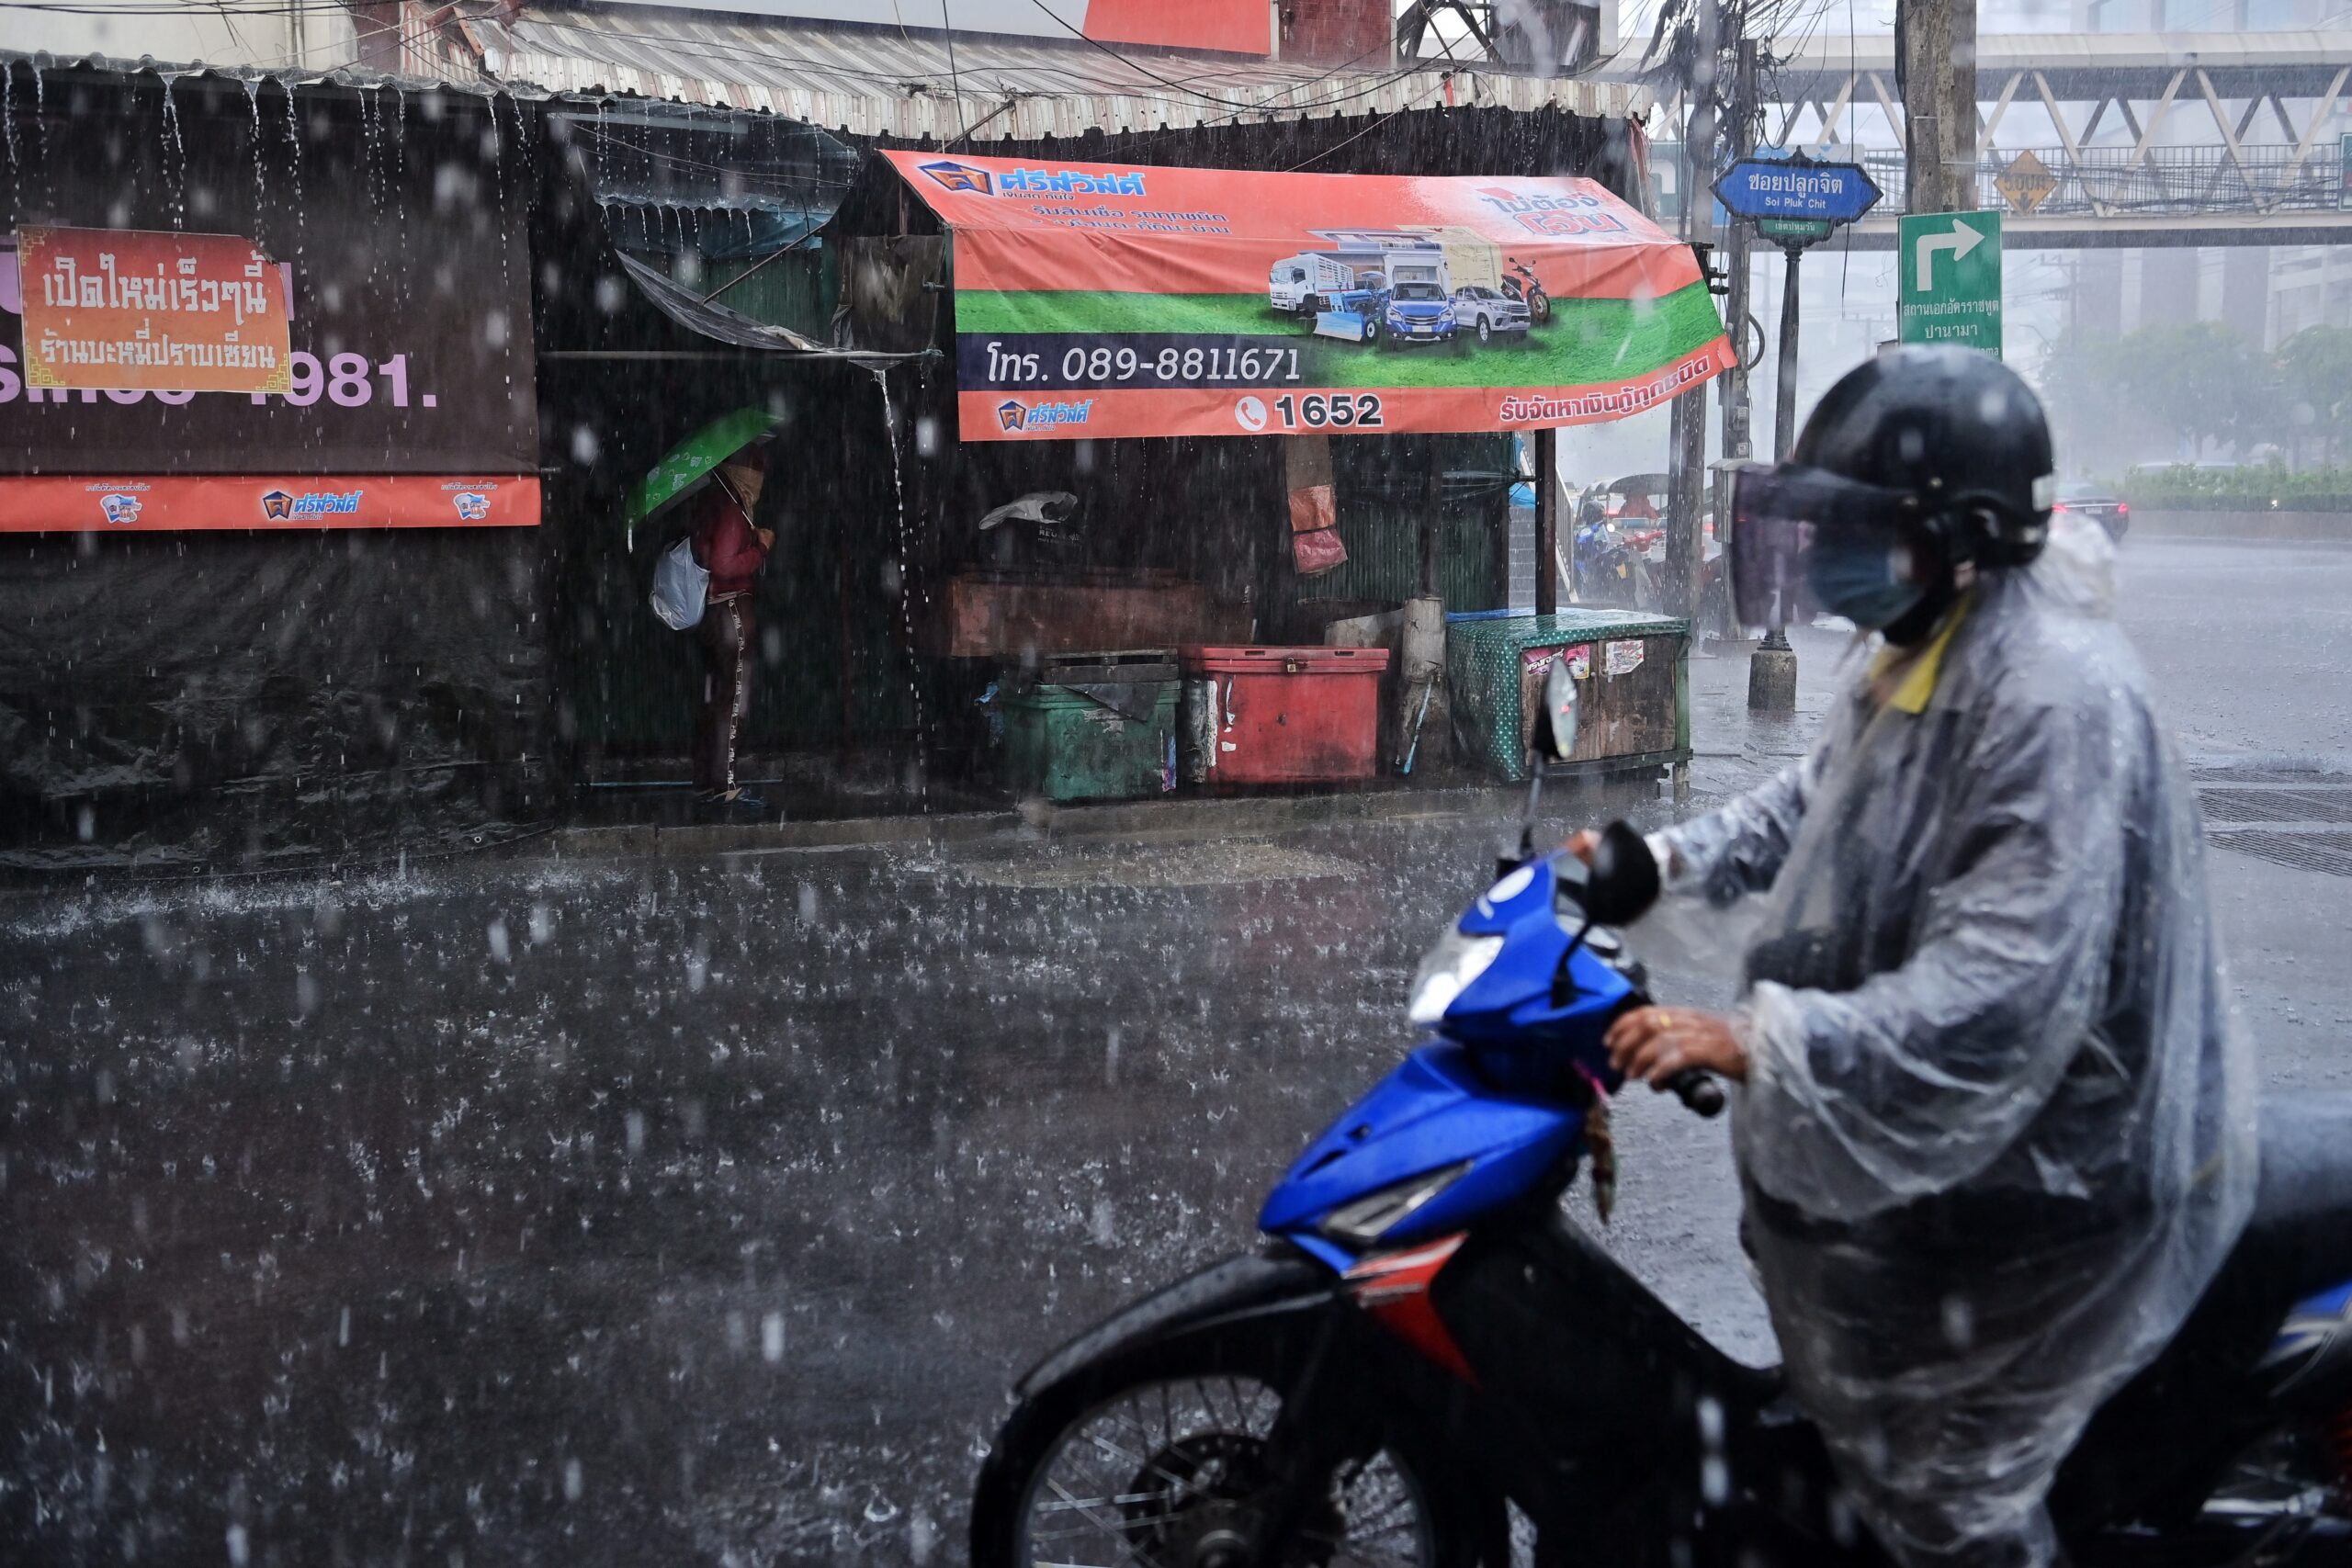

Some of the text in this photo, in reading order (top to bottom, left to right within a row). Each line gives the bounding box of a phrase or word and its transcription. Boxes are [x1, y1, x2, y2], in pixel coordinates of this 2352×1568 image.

[1748, 172, 1843, 198] ซอยปลูกจิต
[1765, 197, 1826, 209] Soi Pluk Chit
[43, 249, 266, 325] เปิดใหม่เร็วๆนี้
[1903, 298, 1999, 317] สถานเอกอัครราชทูต
[40, 318, 276, 368] ร้านบะหมี่ปราบเซียน
[1925, 324, 1978, 339] ปานามา
[986, 342, 1301, 383] โทร. 089-8811671
[1499, 355, 1710, 423] รับจัดหาเงินกู้ทุกชนิด
[1274, 392, 1383, 428] 1652
